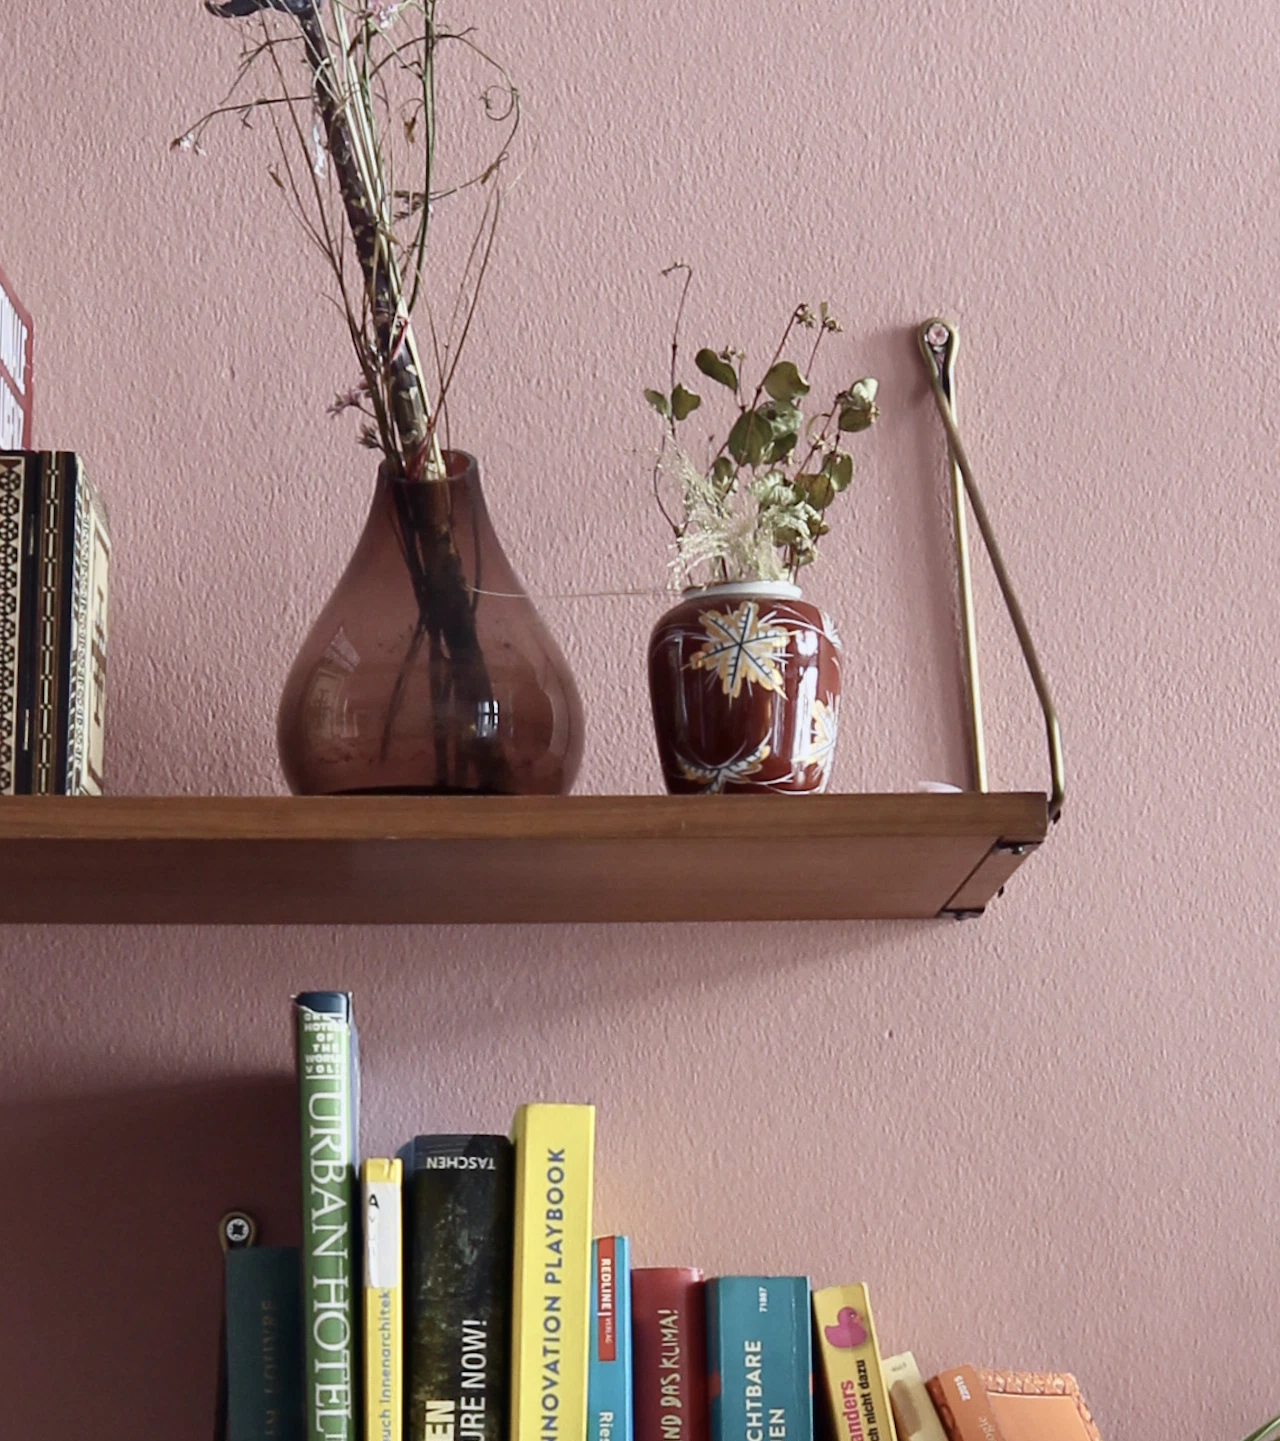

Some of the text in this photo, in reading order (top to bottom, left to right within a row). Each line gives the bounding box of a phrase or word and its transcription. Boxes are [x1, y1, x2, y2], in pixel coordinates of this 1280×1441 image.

[308, 1092, 348, 1260] URBAN
[426, 1156, 496, 1171] TASCHEN
[544, 1148, 565, 1284] PLAYBOOK
[601, 1258, 612, 1310] REDLINE
[313, 1276, 351, 1433] HOTEL
[461, 1319, 487, 1389] NOW!
[657, 1309, 681, 1369] KLIMA!
[660, 1372, 682, 1409] DAS
[856, 1359, 869, 1389] dazu
[861, 1392, 876, 1424] nicht
